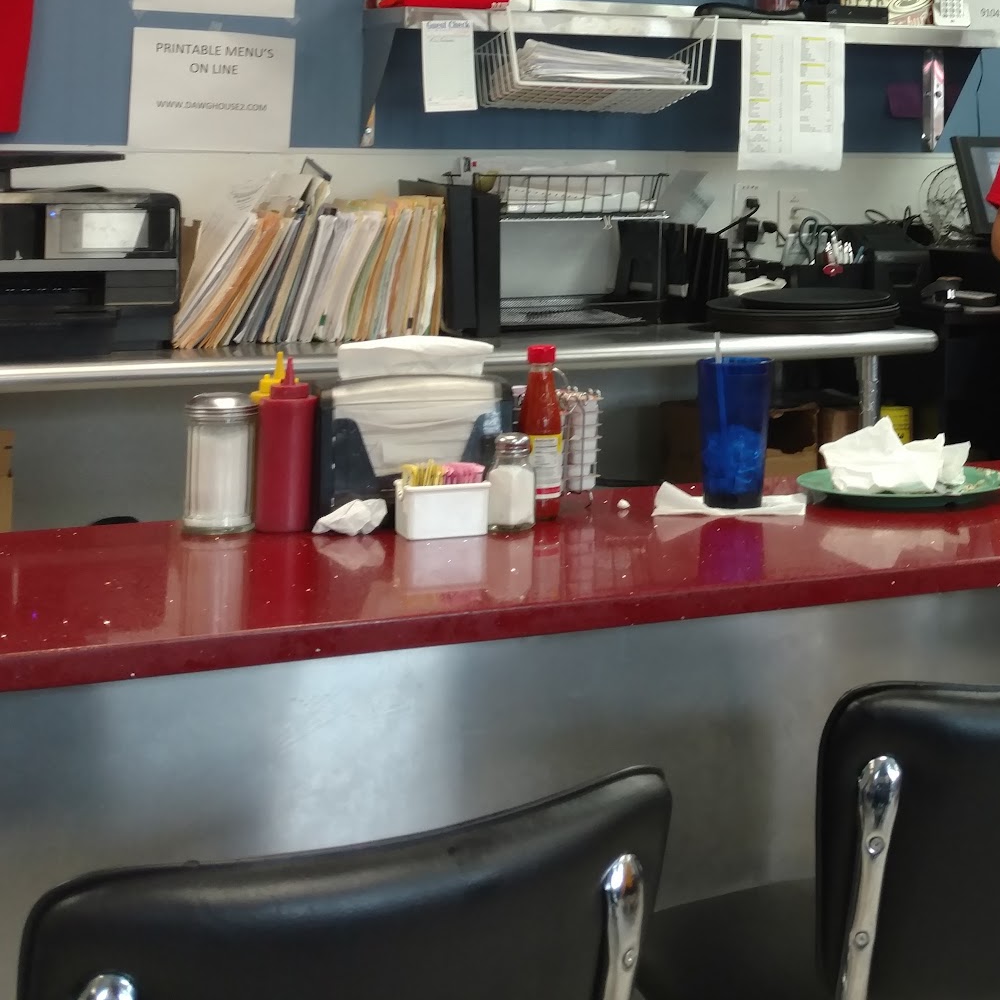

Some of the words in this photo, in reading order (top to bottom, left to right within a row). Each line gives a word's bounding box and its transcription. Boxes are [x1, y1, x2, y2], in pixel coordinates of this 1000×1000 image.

[155, 42, 222, 56] PRINTABLE
[189, 63, 209, 74] ON
[212, 64, 239, 75] LINE
